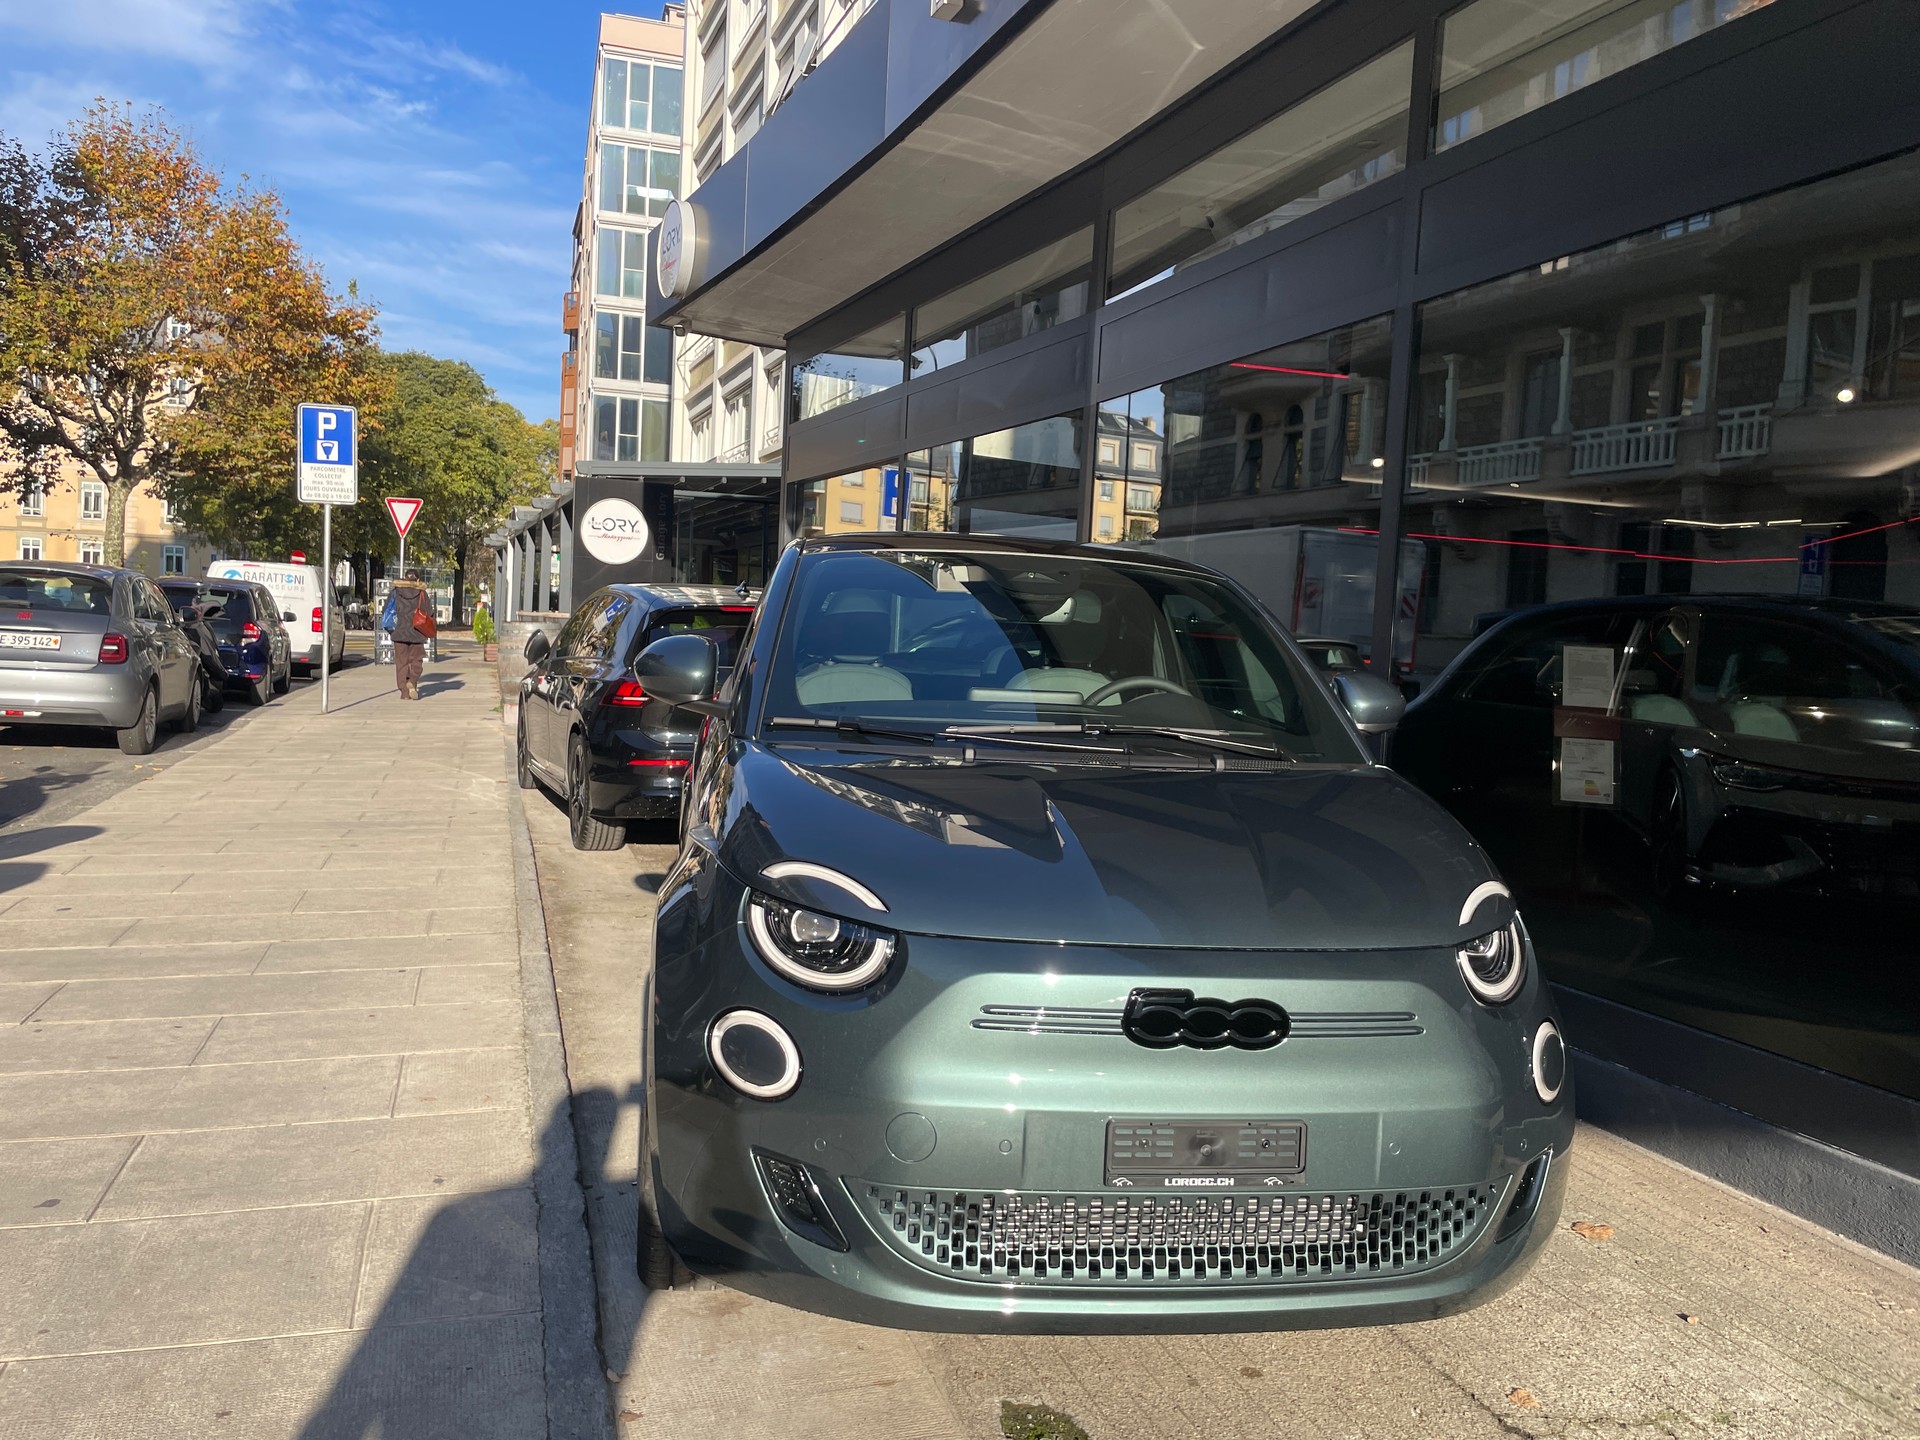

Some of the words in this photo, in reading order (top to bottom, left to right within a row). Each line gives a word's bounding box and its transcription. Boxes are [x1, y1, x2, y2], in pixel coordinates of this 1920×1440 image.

[662, 224, 680, 254] LORY
[318, 411, 336, 439] P
[591, 517, 639, 533] LORY
[656, 521, 668, 560] Garage
[269, 584, 304, 592] NSEURS
[1164, 1177, 1235, 1186] LOROCC.CH
